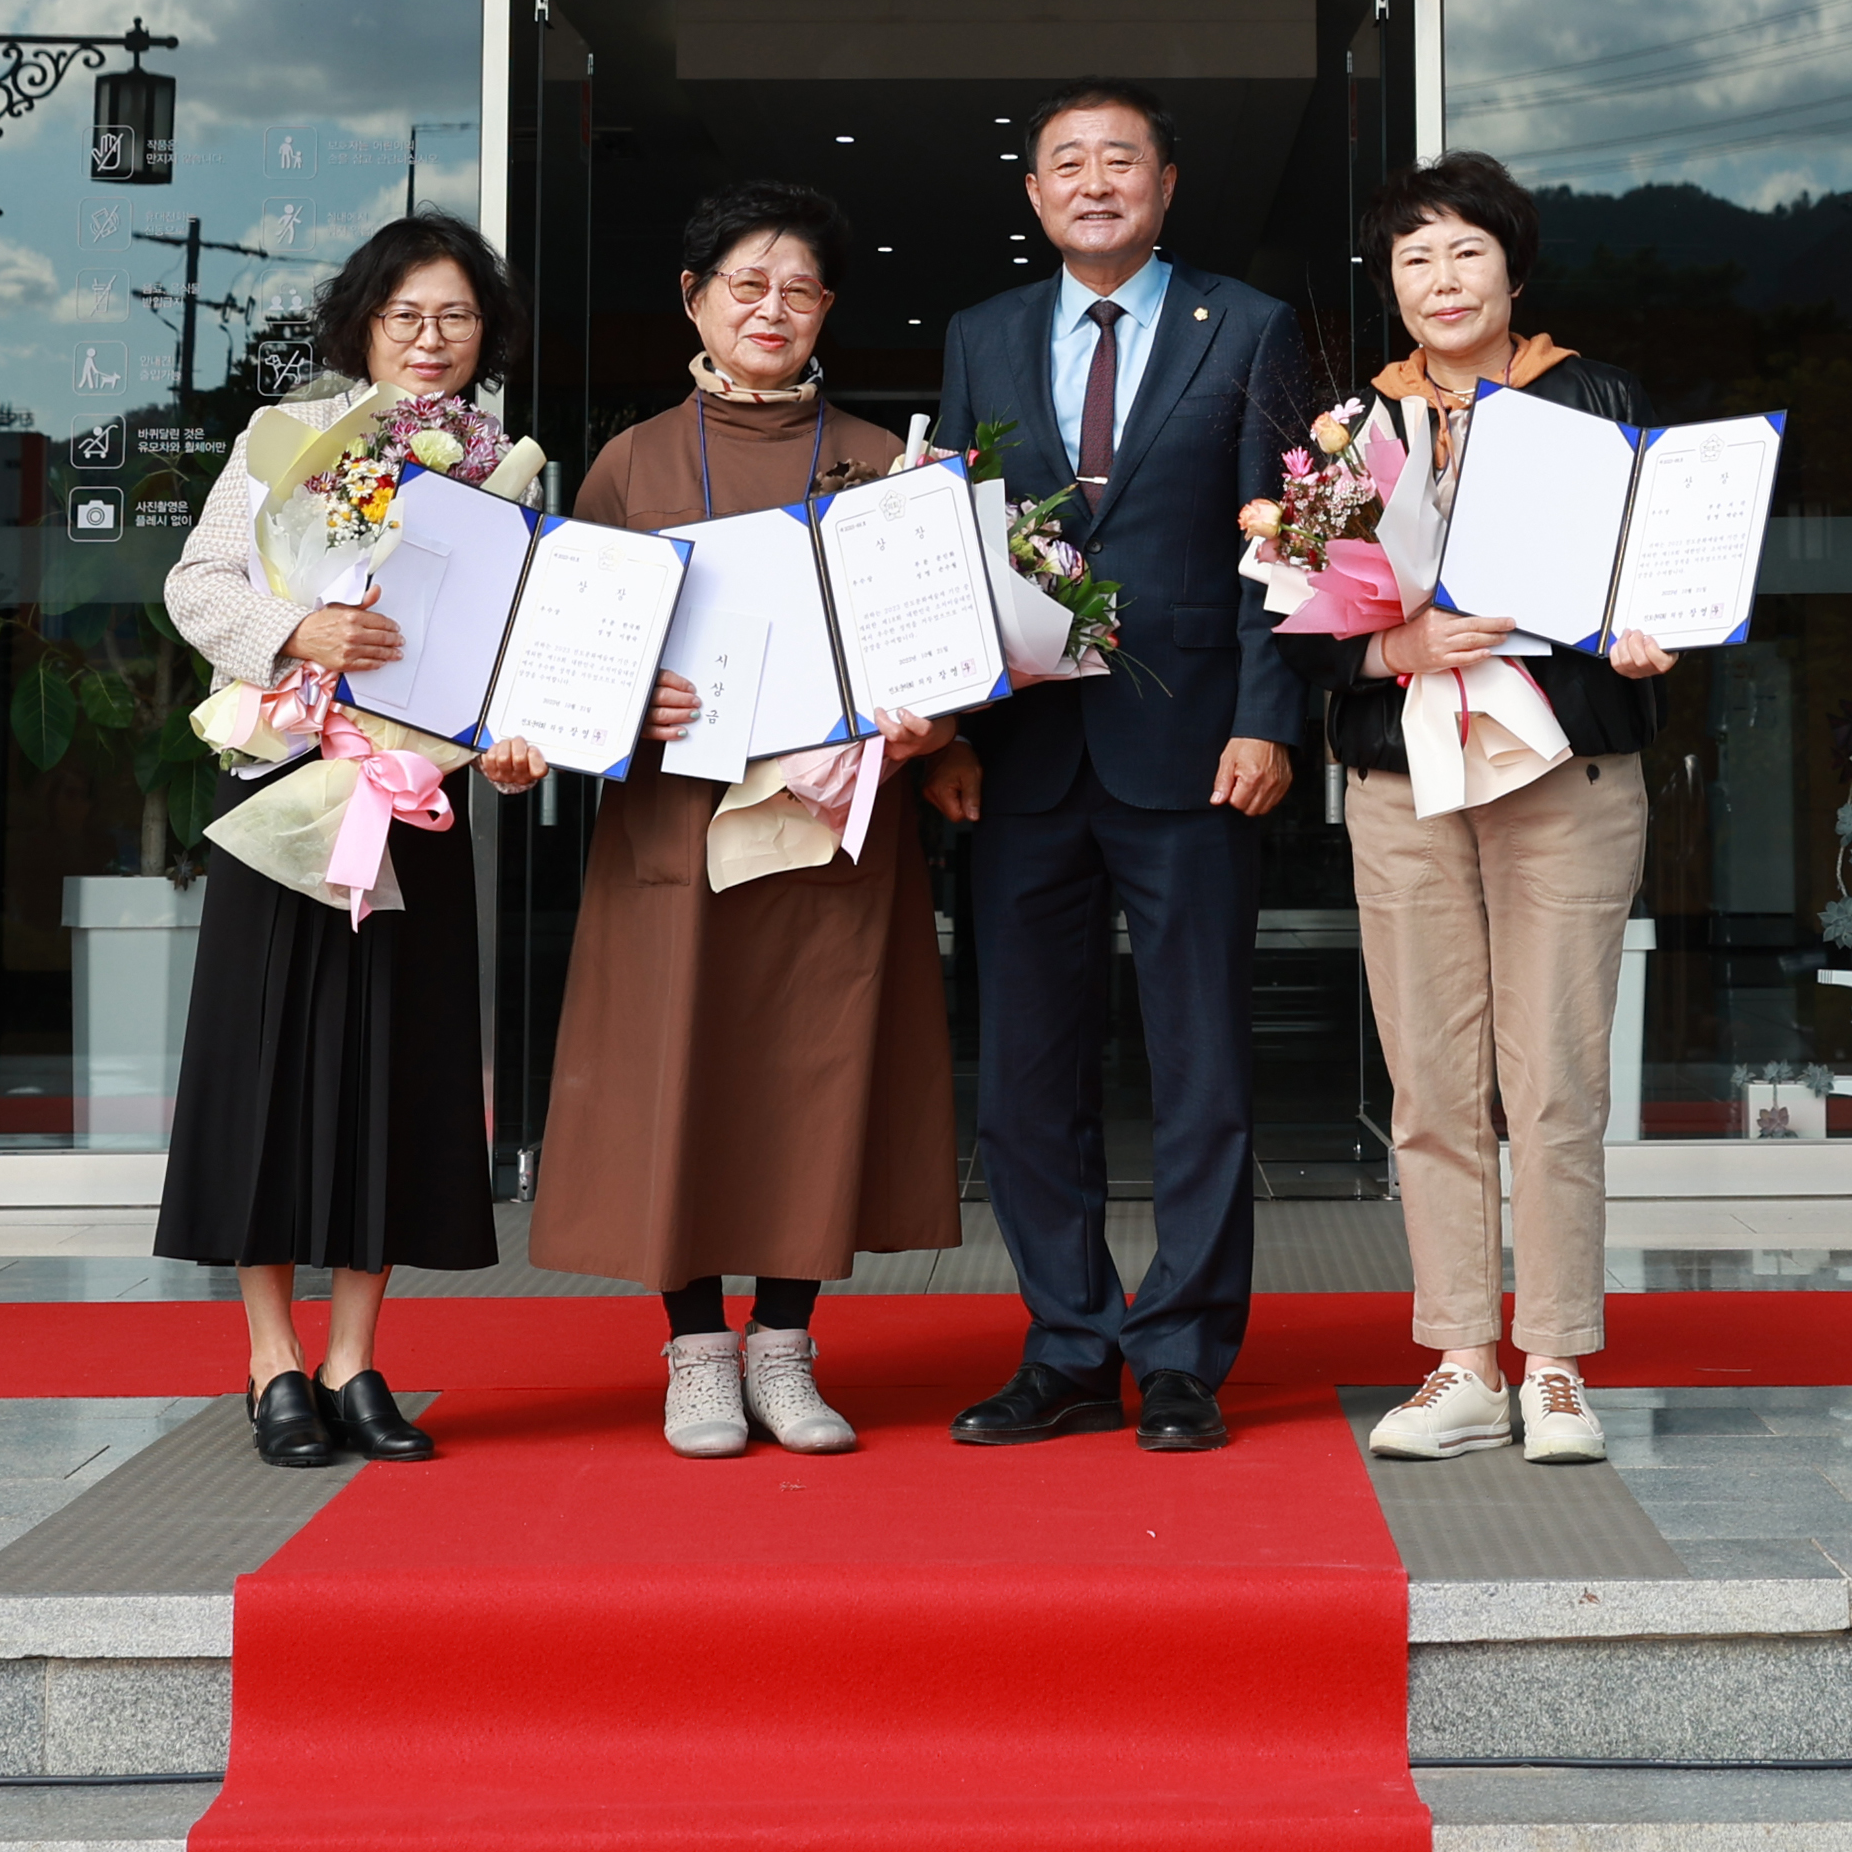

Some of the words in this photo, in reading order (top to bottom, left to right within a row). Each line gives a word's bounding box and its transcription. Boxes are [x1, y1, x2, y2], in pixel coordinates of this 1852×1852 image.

[137, 428, 181, 440] 바퀴달린
[184, 428, 205, 440] 것은
[137, 442, 181, 453] 유모차와
[184, 442, 226, 454] 휠체어만
[135, 501, 189, 513] 사진촬영은
[171, 515, 193, 527] 없이
